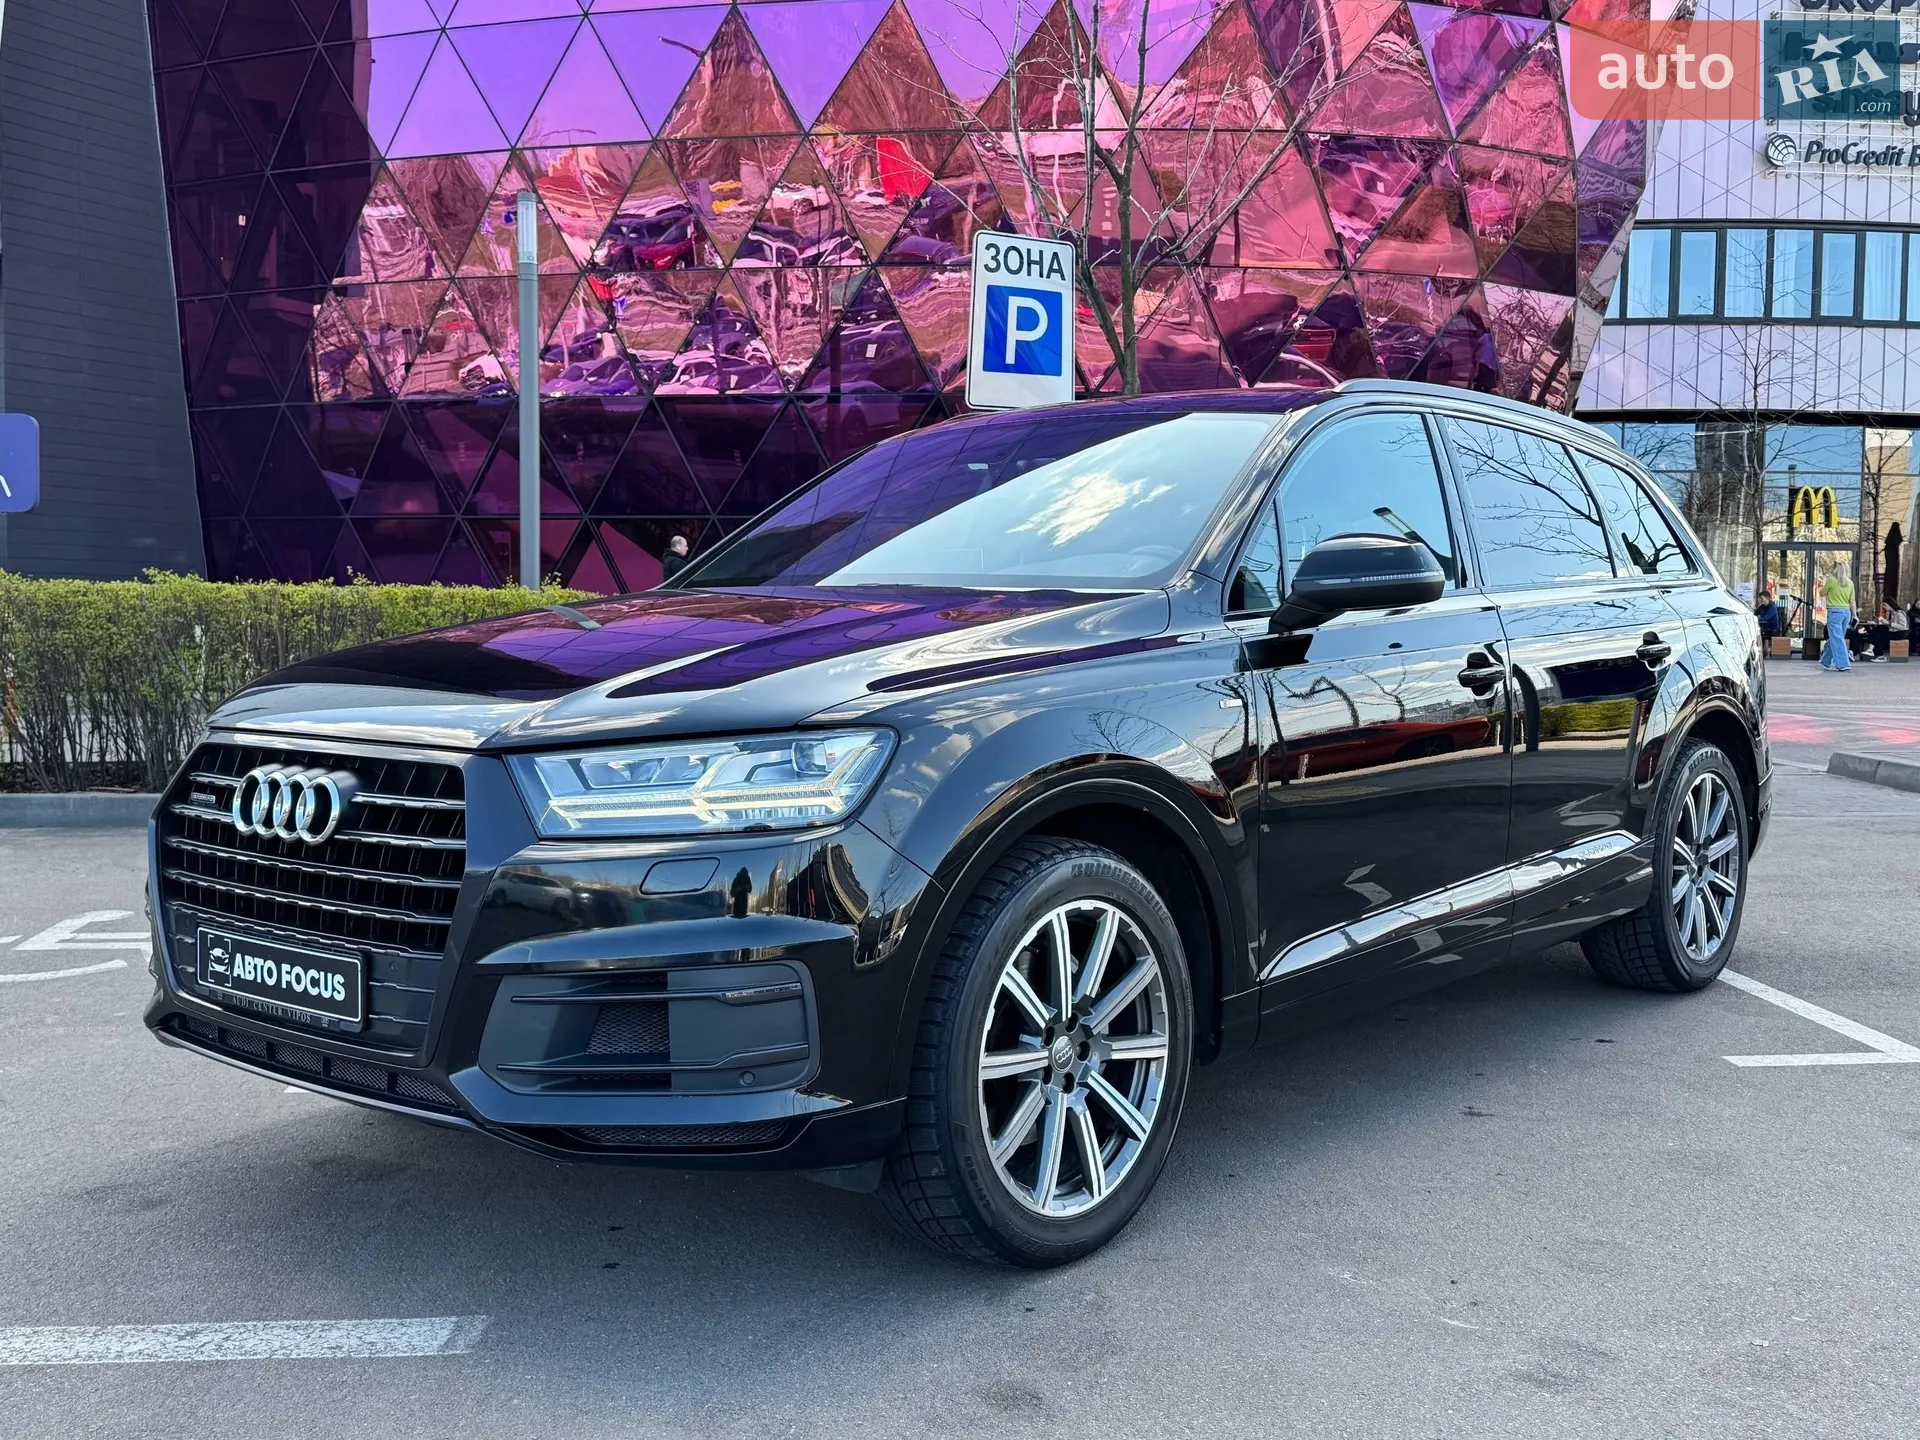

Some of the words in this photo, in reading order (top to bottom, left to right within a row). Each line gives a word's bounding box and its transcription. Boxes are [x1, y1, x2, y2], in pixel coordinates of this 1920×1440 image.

[1804, 140, 1905, 166] ProCredit
[983, 242, 1067, 282] ЗОНА
[1005, 295, 1048, 365] P
[233, 953, 278, 986] АВТО
[282, 963, 346, 1001] FOCUS
[232, 996, 250, 1007] AUDI
[253, 1002, 283, 1016] CENTER
[288, 1008, 311, 1023] VIPOS
